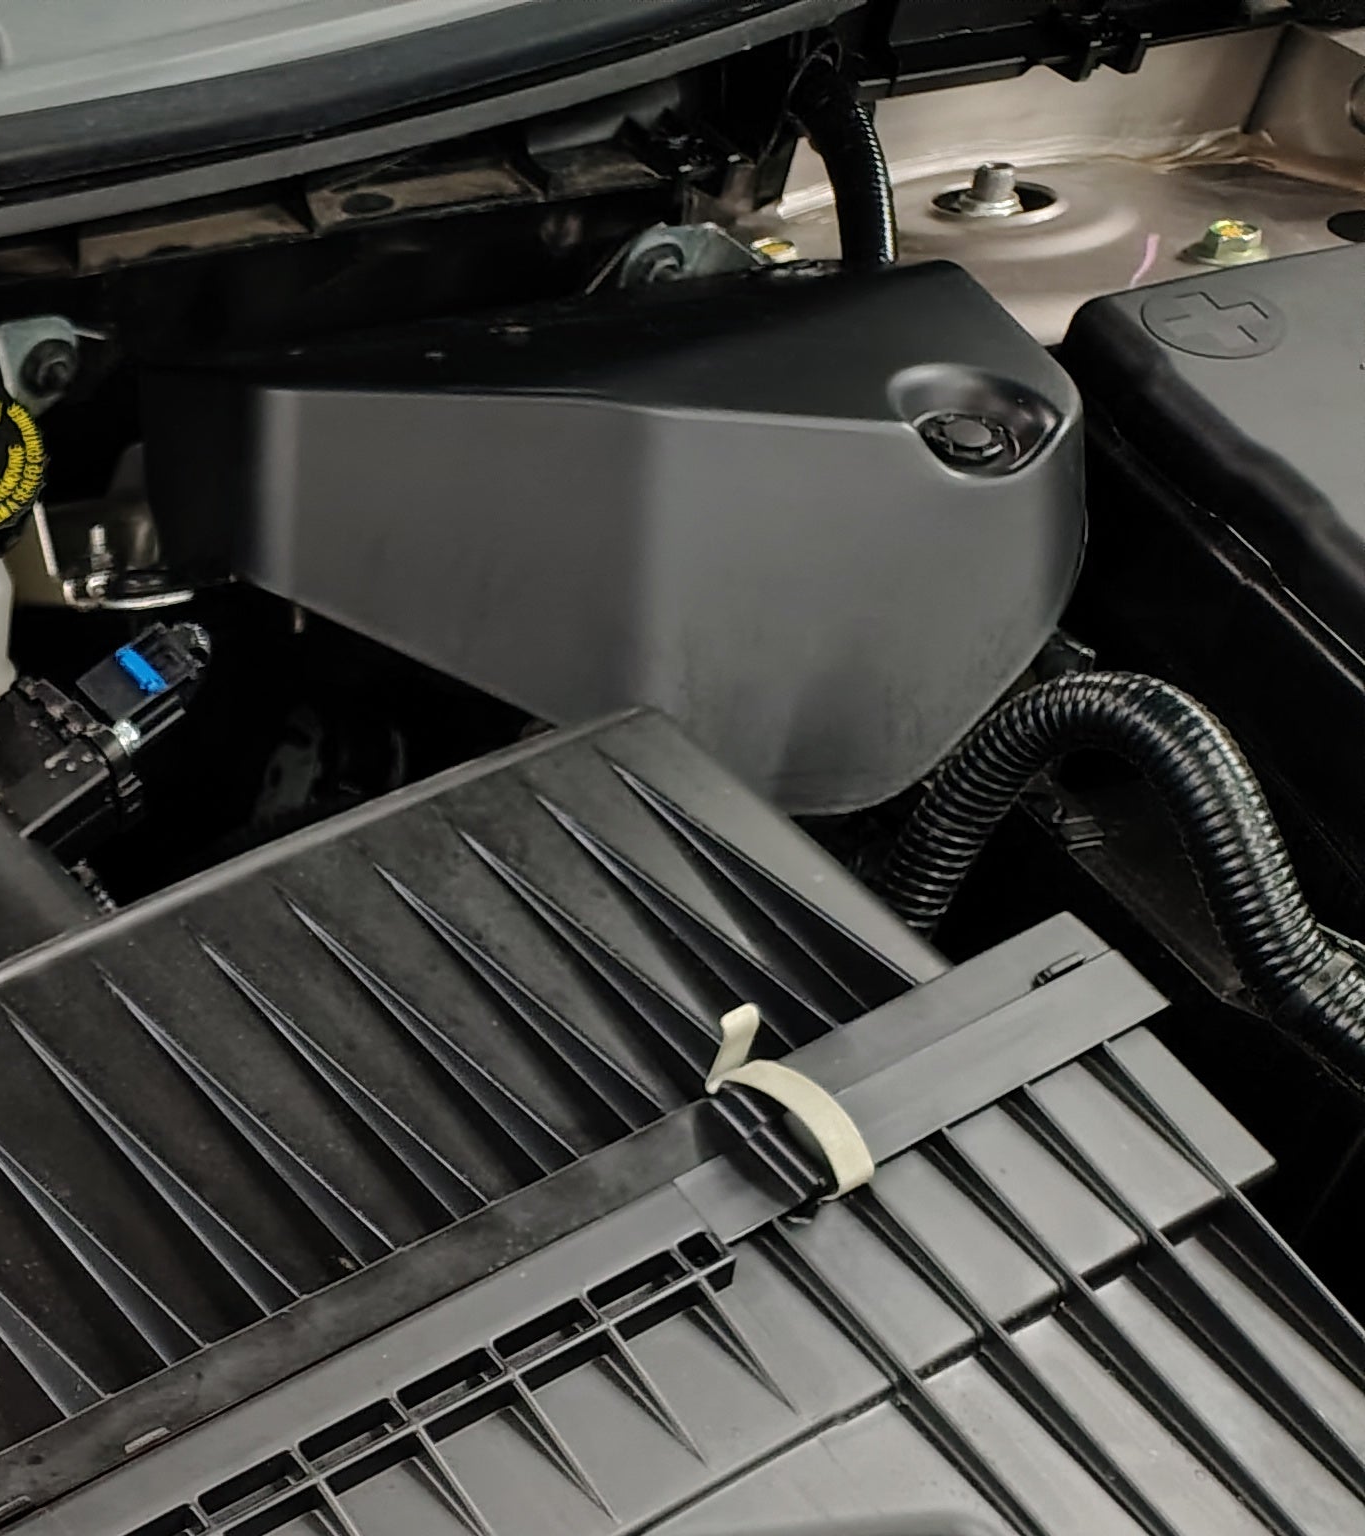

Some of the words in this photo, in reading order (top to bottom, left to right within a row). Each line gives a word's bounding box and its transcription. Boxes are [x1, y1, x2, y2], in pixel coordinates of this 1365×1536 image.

[7, 403, 43, 463] CONTAINER
[12, 464, 42, 502] SEALED
[6, 499, 20, 513] A
